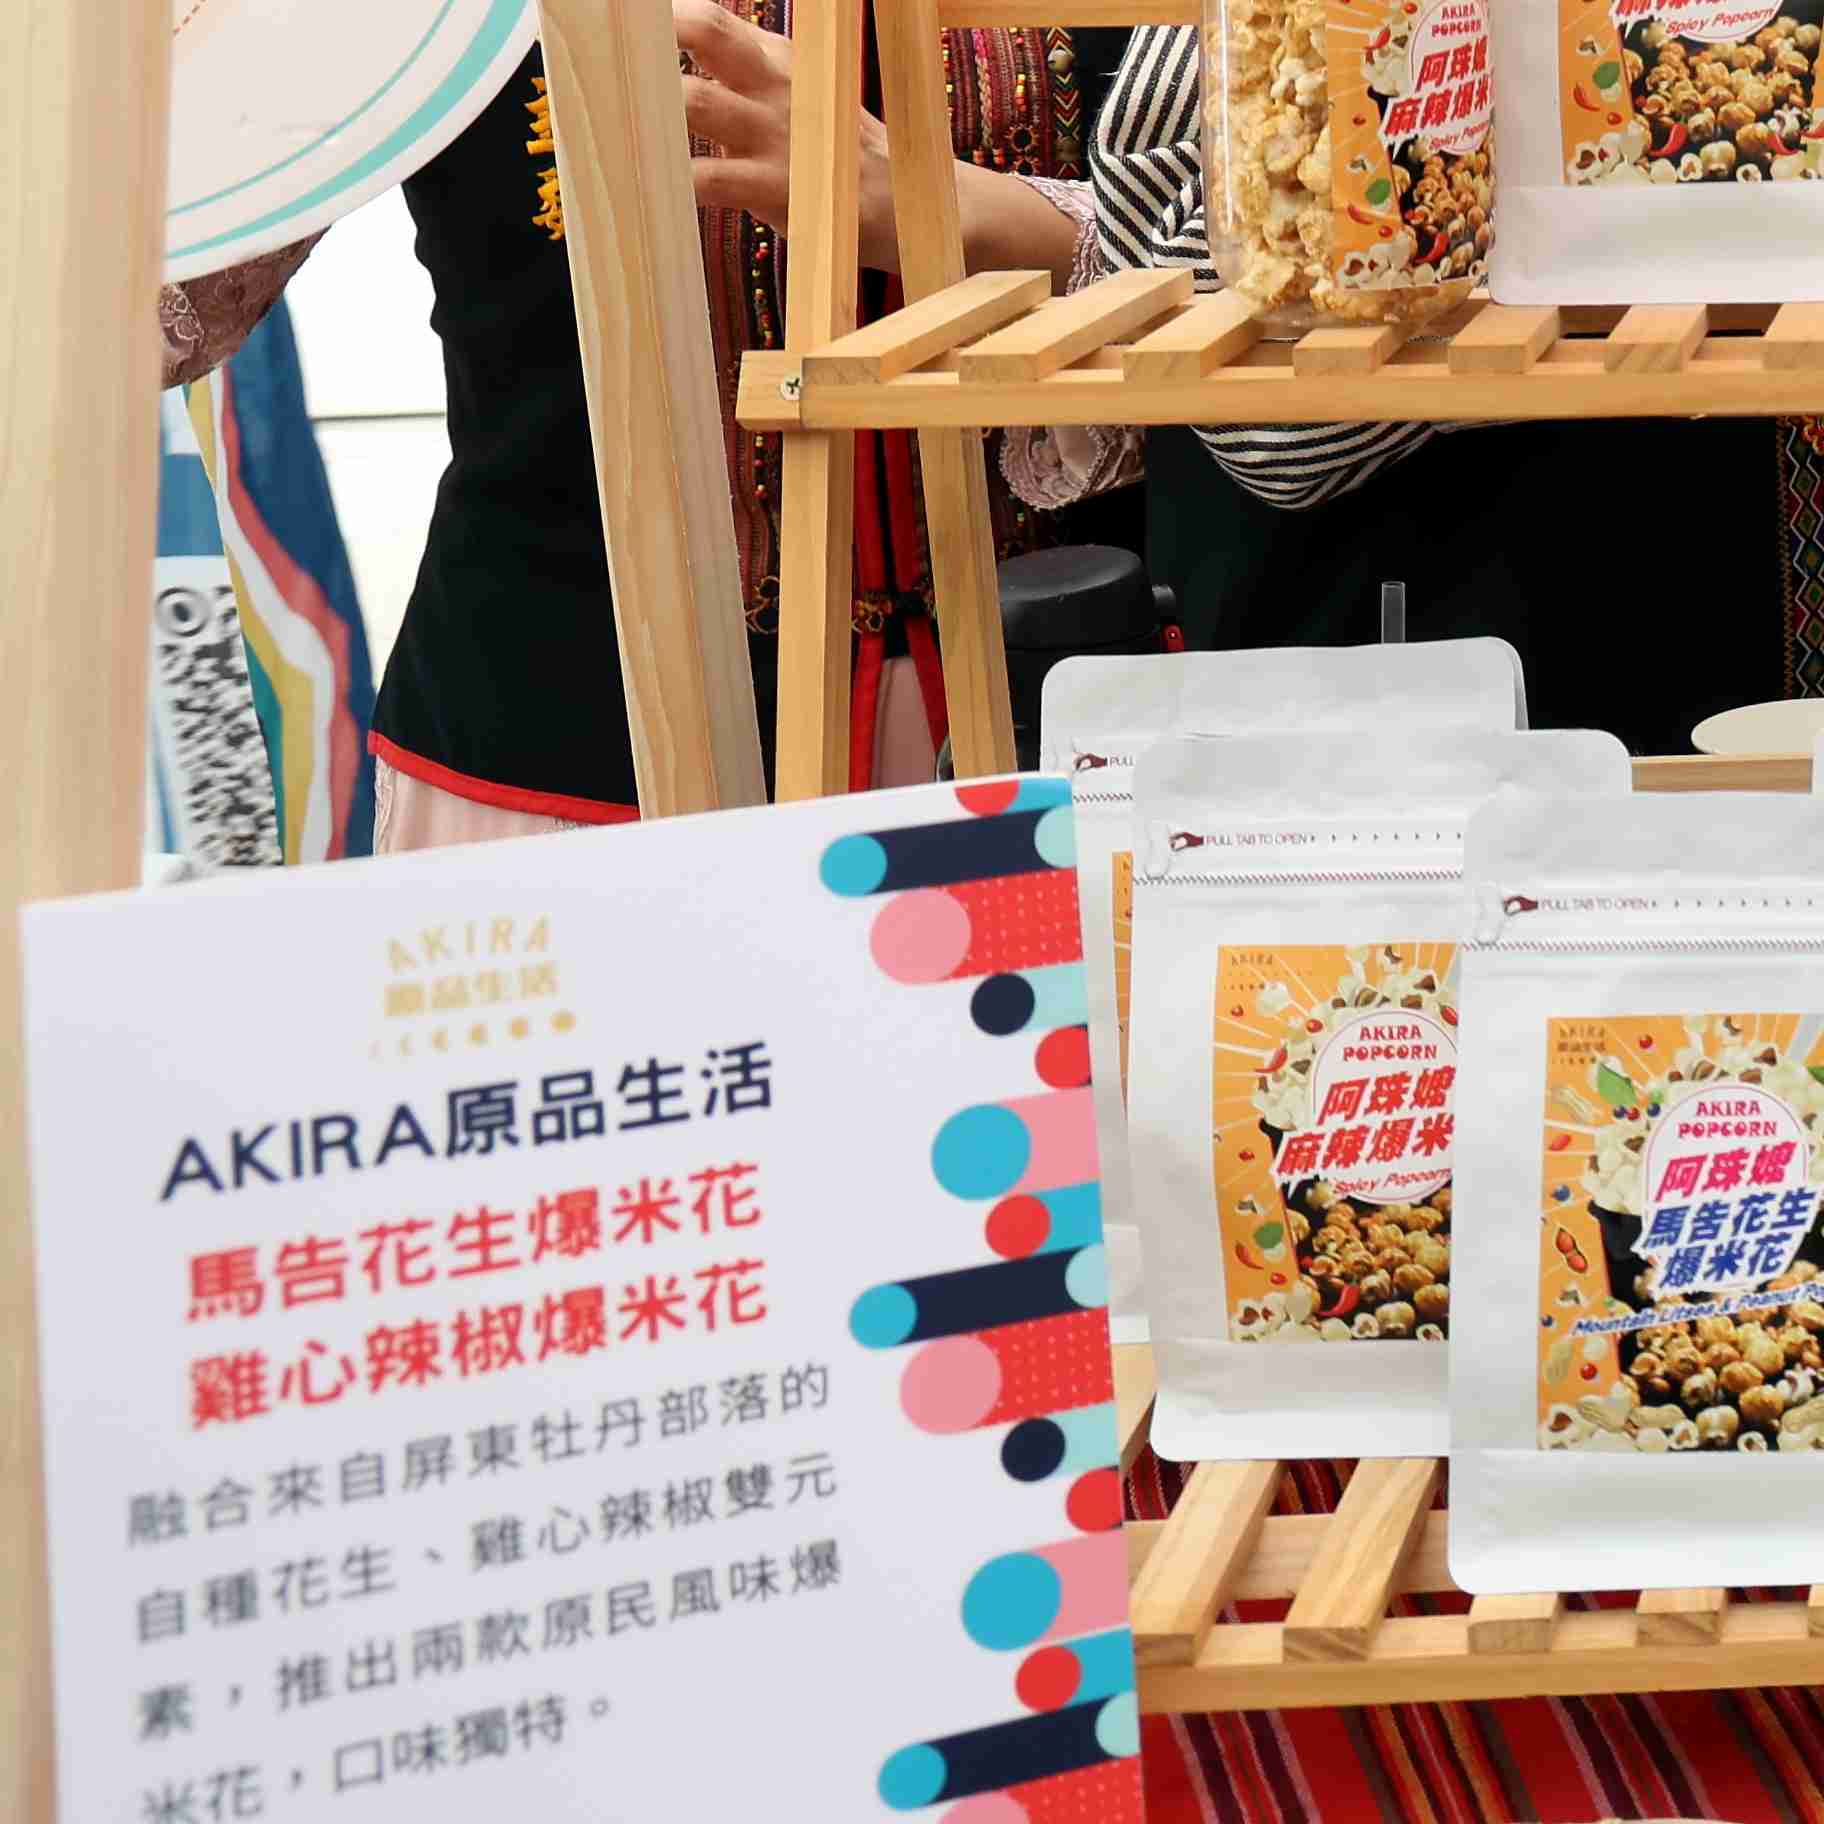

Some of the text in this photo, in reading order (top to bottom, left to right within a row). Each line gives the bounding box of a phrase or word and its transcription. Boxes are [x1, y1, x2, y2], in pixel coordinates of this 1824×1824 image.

[1442, 5, 1474, 19] AKIRA
[1667, 7, 1774, 34] Spicy Popcorn
[386, 914, 551, 973] AKIRA
[1343, 1045, 1437, 1060] POPCORN
[1360, 1025, 1421, 1040] AKIRA
[157, 1042, 776, 1202] AKIRA原品生活
[1678, 1122, 1777, 1138] POPCORN
[1696, 1101, 1761, 1117] AKIRA
[185, 1163, 764, 1323] 馬告花生爆米花
[1642, 1188, 1818, 1248] 馬告花生
[1659, 1233, 1792, 1289] 爆米花
[187, 1260, 770, 1429] 雞心辣椒爆米花
[125, 1361, 832, 1545] 融合來自屏東牡丹部落的
[134, 1453, 839, 1644] 自種花生、雞心辣椒雙元
[136, 1538, 843, 1743] 素，推出兩款原民風味爆
